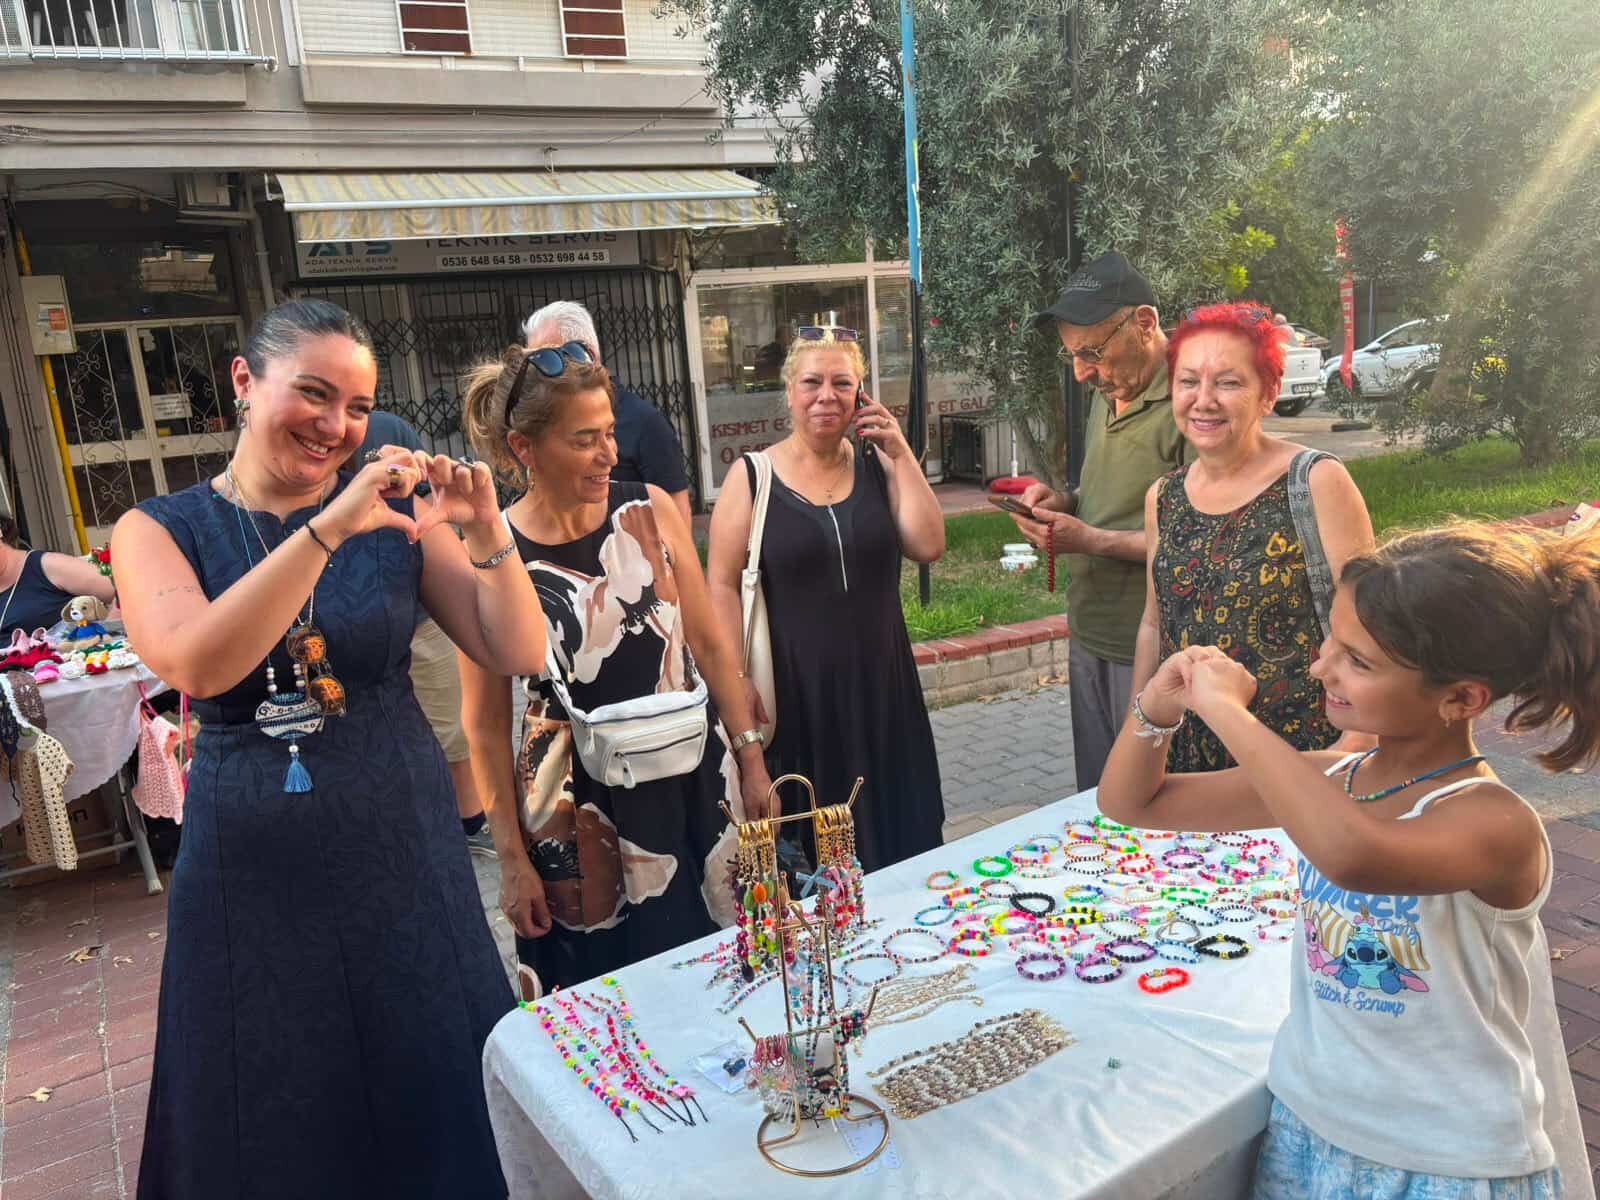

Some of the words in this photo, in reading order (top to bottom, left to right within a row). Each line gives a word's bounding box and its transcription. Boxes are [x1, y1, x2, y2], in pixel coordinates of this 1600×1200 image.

[441, 256, 468, 267] 0536
[471, 255, 490, 266] 648
[493, 255, 505, 265] 64
[508, 254, 521, 264] 58
[529, 253, 554, 264] 0532
[556, 252, 575, 263] 698
[578, 251, 590, 261] 44
[592, 251, 605, 261] 58
[938, 400, 957, 413] ET
[711, 419, 769, 439] KISMET
[1312, 980, 1341, 1003] Stitch
[1353, 990, 1406, 1018] Scrump
